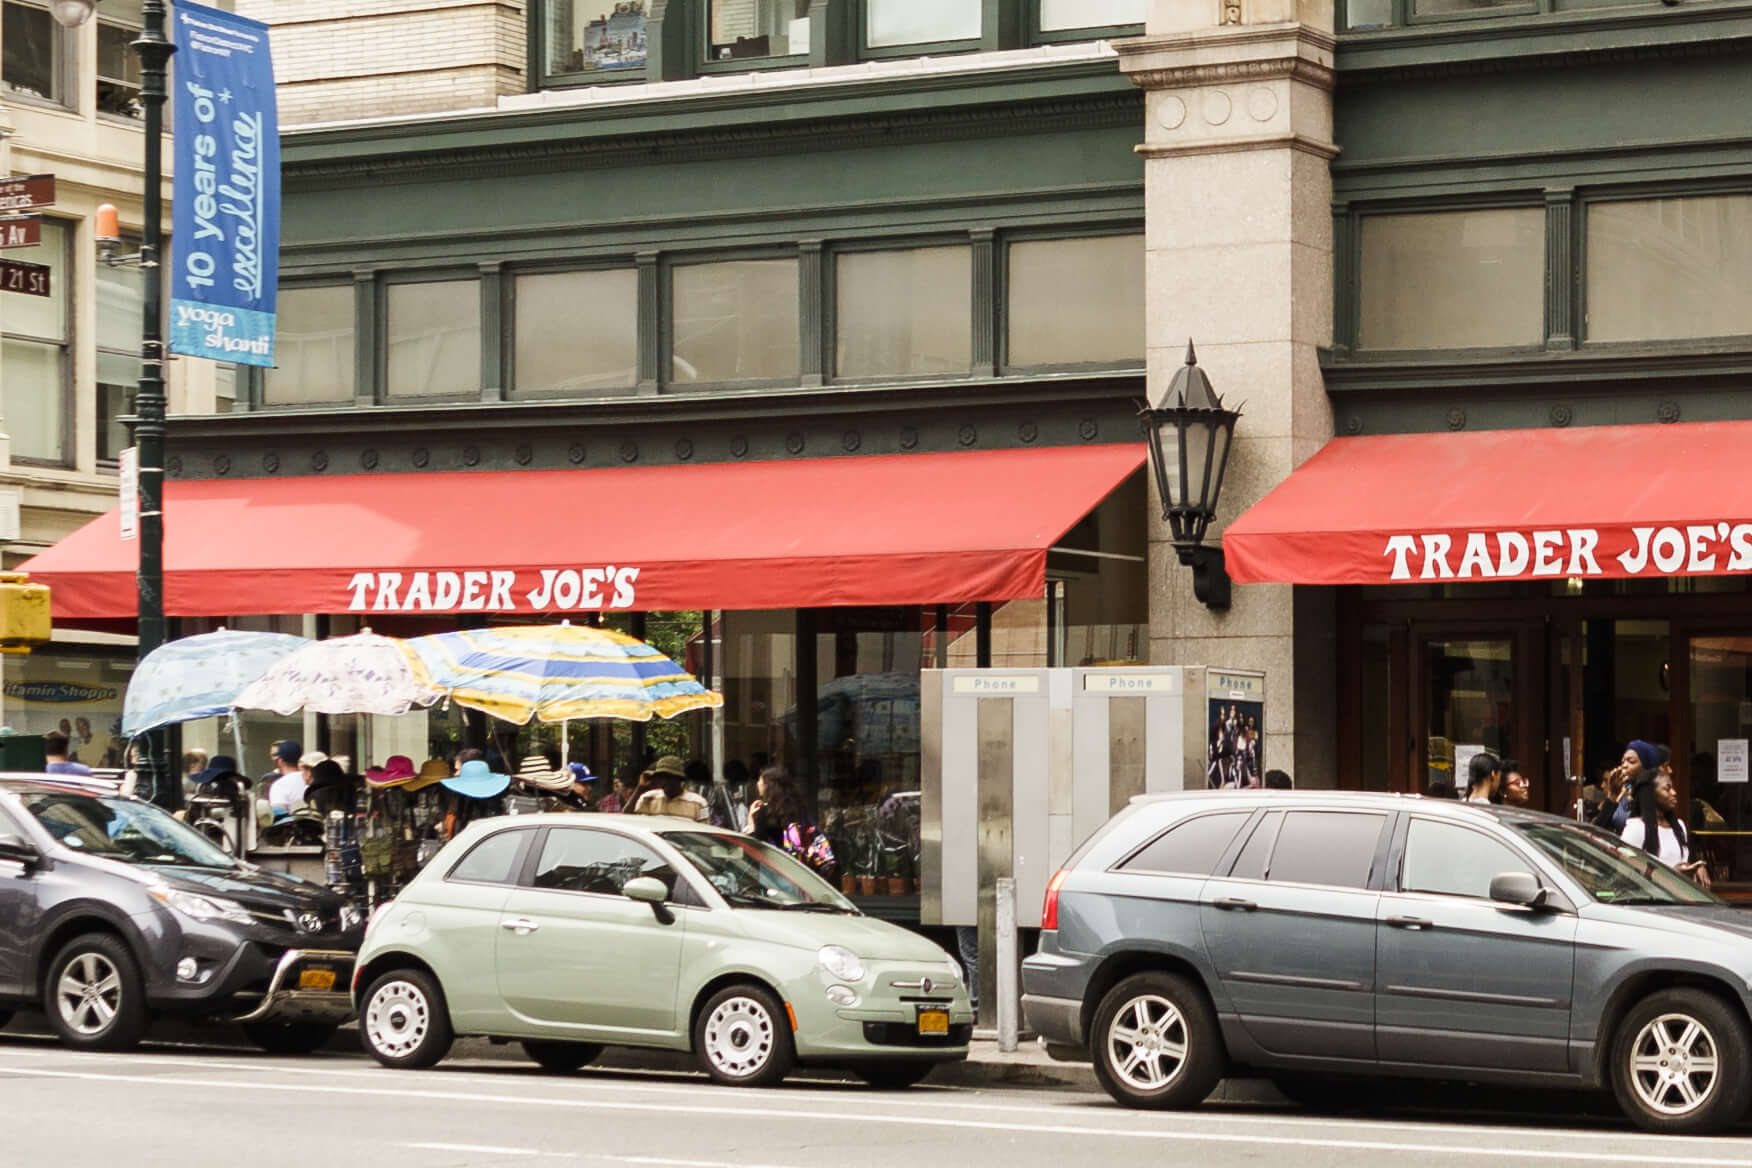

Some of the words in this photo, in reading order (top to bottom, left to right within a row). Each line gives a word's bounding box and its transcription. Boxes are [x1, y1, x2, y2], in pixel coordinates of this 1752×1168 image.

[186, 81, 215, 122] of
[194, 134, 224, 241] years
[8, 268, 24, 289] 21
[29, 272, 46, 293] St
[186, 252, 215, 289] 10
[177, 305, 234, 330] yoga
[204, 326, 270, 356] shanti
[1383, 528, 1602, 580] TRADER
[347, 570, 516, 610] TRADER
[526, 565, 641, 609] JOE'S
[59, 684, 117, 700] Shoppe
[974, 678, 1017, 690] Phone
[1109, 677, 1153, 689] Phone
[1219, 676, 1252, 690] Phone
